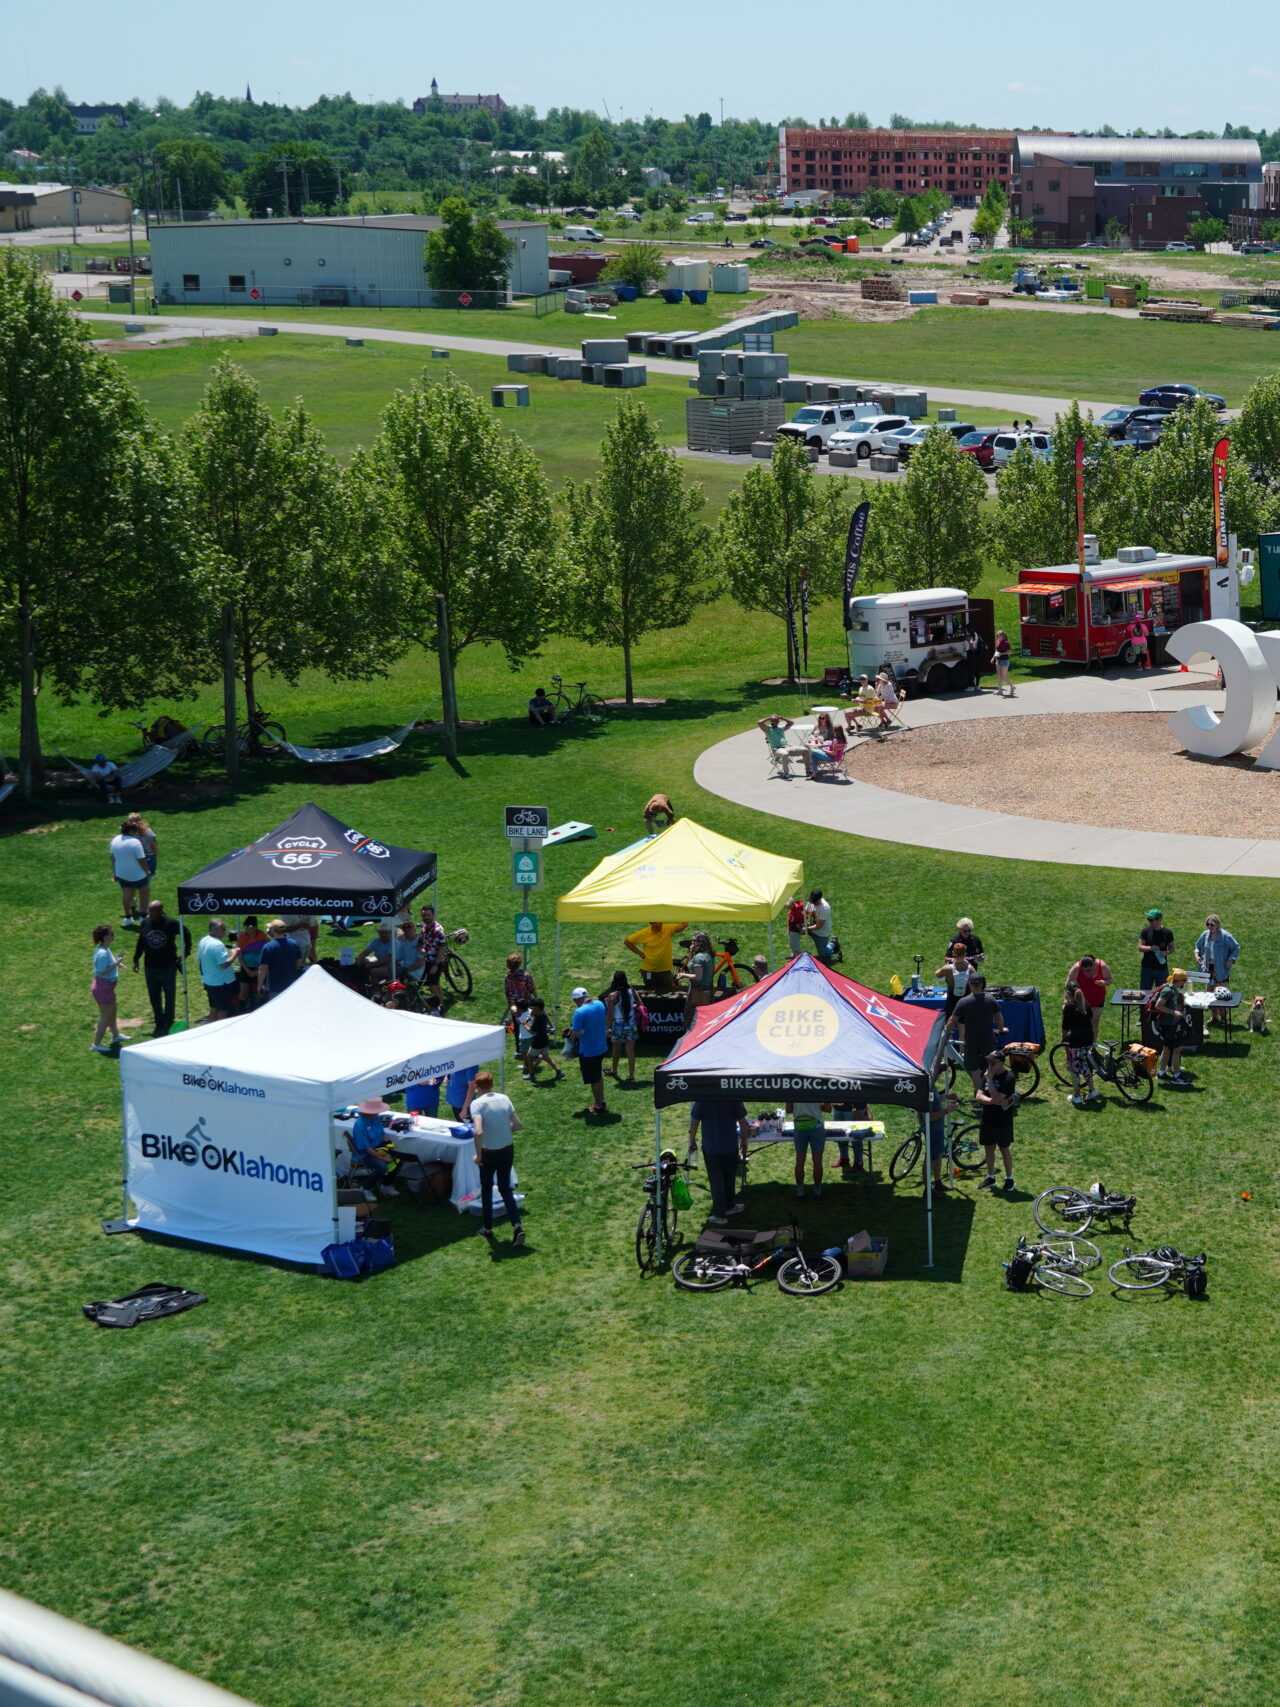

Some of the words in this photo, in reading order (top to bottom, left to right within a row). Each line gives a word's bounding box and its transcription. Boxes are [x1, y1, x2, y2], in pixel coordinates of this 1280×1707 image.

[508, 827, 523, 836] BIKE
[527, 827, 545, 836] LANE
[284, 839, 320, 849] CYCLE
[282, 853, 313, 865] 66
[520, 874, 533, 882] 66
[223, 896, 354, 909] www.cycle66ok.com
[649, 1012, 685, 1024] KLAH
[774, 1009, 824, 1023] BIKE
[770, 1025, 826, 1037] CLUB
[182, 1073, 206, 1089] Bike
[208, 1079, 266, 1099] OKlahoma
[720, 1077, 862, 1091] BIKECLUBOKC.COM
[141, 1133, 197, 1164] Bike
[201, 1143, 324, 1193] OKlahoma
